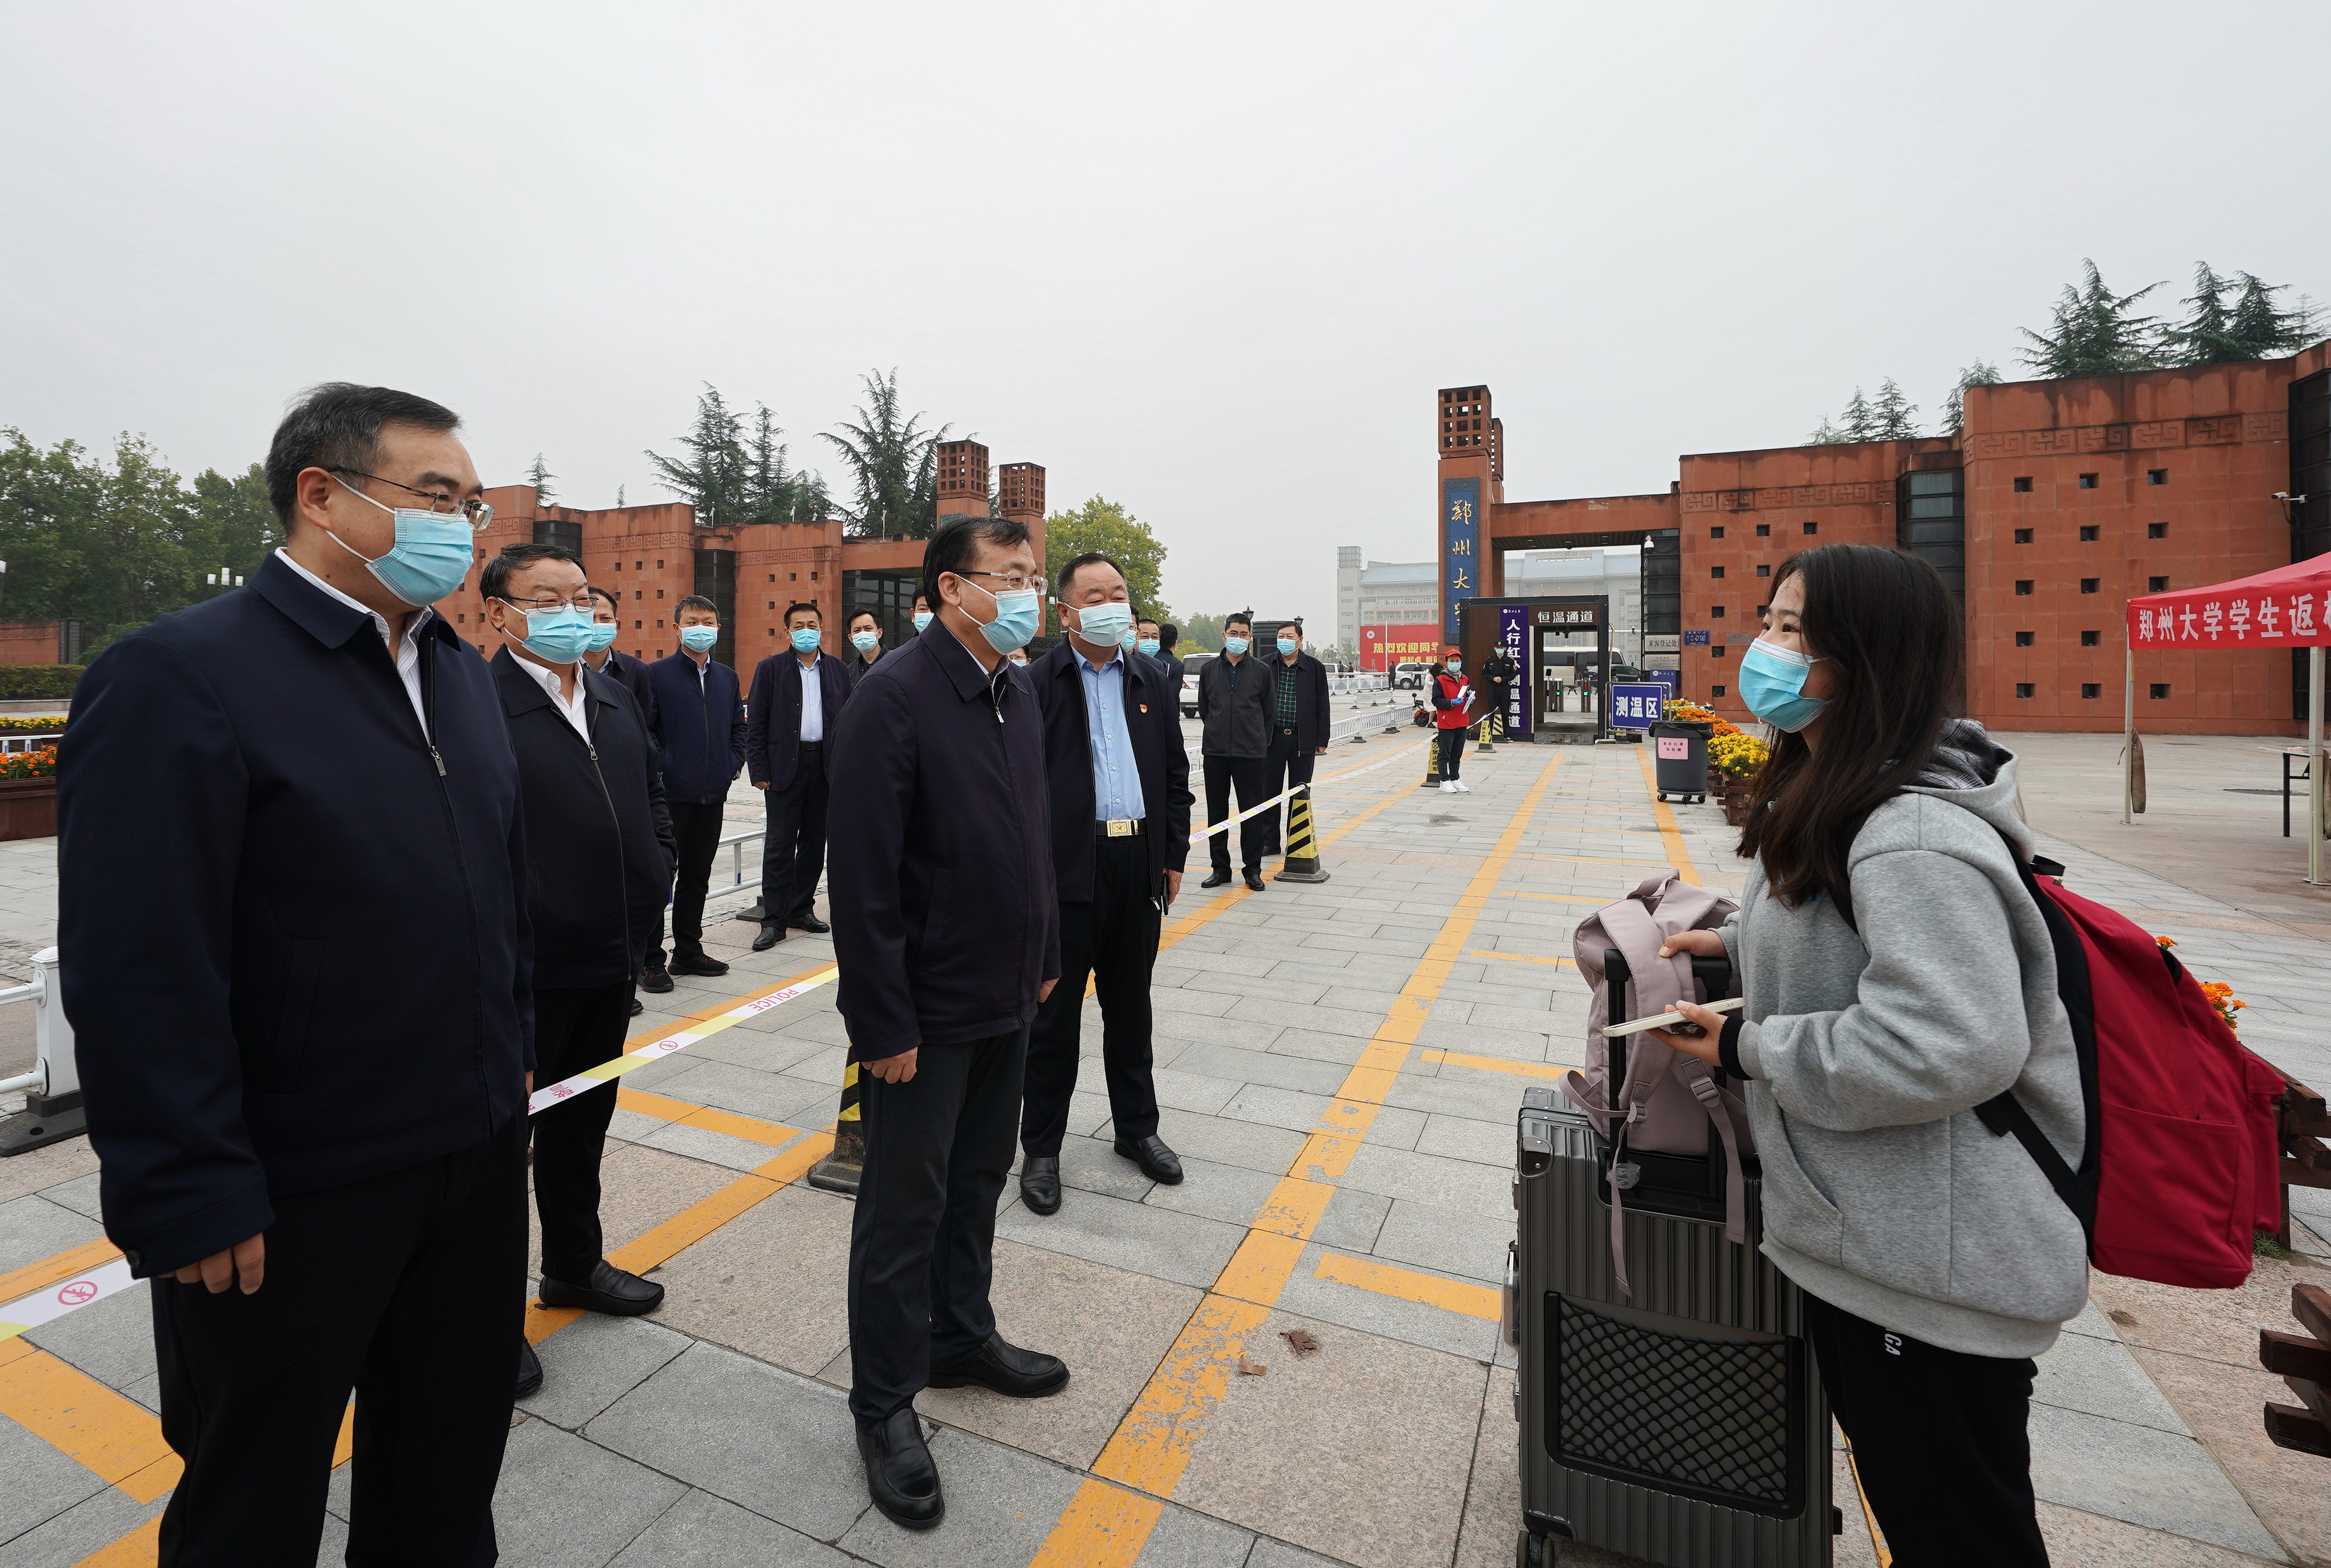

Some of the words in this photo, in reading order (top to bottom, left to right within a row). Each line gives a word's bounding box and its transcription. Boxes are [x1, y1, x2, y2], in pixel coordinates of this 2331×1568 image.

[1538, 611, 1593, 623] 恒温通道
[1616, 696, 1658, 718] 测温区
[748, 989, 800, 1011] POLICE
[1884, 1329, 1902, 1355] GA
